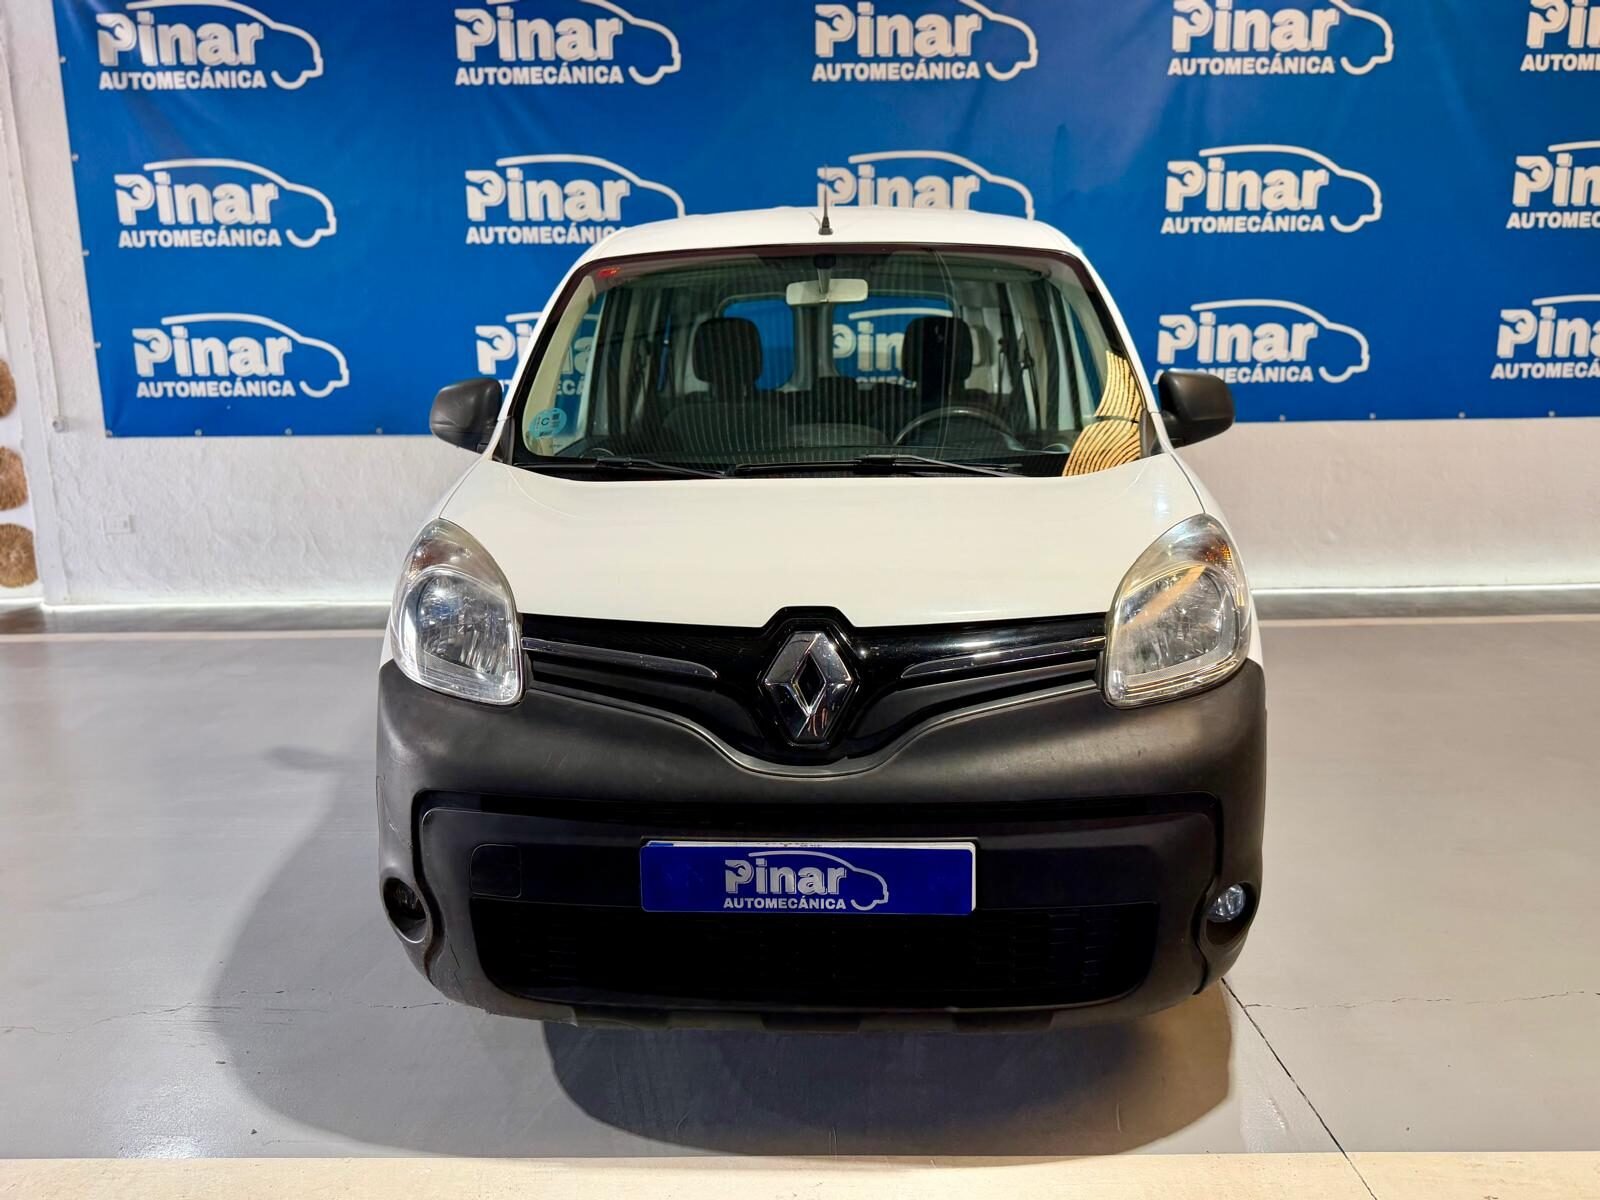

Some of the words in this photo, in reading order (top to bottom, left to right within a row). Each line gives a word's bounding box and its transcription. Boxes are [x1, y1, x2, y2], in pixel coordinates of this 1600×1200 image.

[96, 11, 264, 66] Pinar
[455, 6, 623, 61] Pinar
[815, 2, 982, 57] Pinar
[1172, 0, 1340, 52] Pinar
[99, 67, 267, 90] AUTOMECÁNICA
[455, 62, 624, 86] AUTOMECÁNICA
[812, 58, 981, 81] AUTOMECÁNICA
[1167, 53, 1336, 75] AUTOMECÁNICA
[115, 171, 279, 225] Pinar
[465, 167, 630, 222] Pinar
[816, 164, 981, 209] Pinar
[1165, 157, 1329, 212] Pinar
[118, 225, 282, 248] AUTOMECÁNICA
[1161, 212, 1325, 234] AUTOMECÁNICA
[133, 319, 293, 376] Pinar
[1157, 311, 1319, 364] Pinar
[136, 376, 296, 398] AUTOMECÁNICA
[725, 858, 847, 895] Pinar
[724, 895, 847, 910] AUTOMECÁNICA
